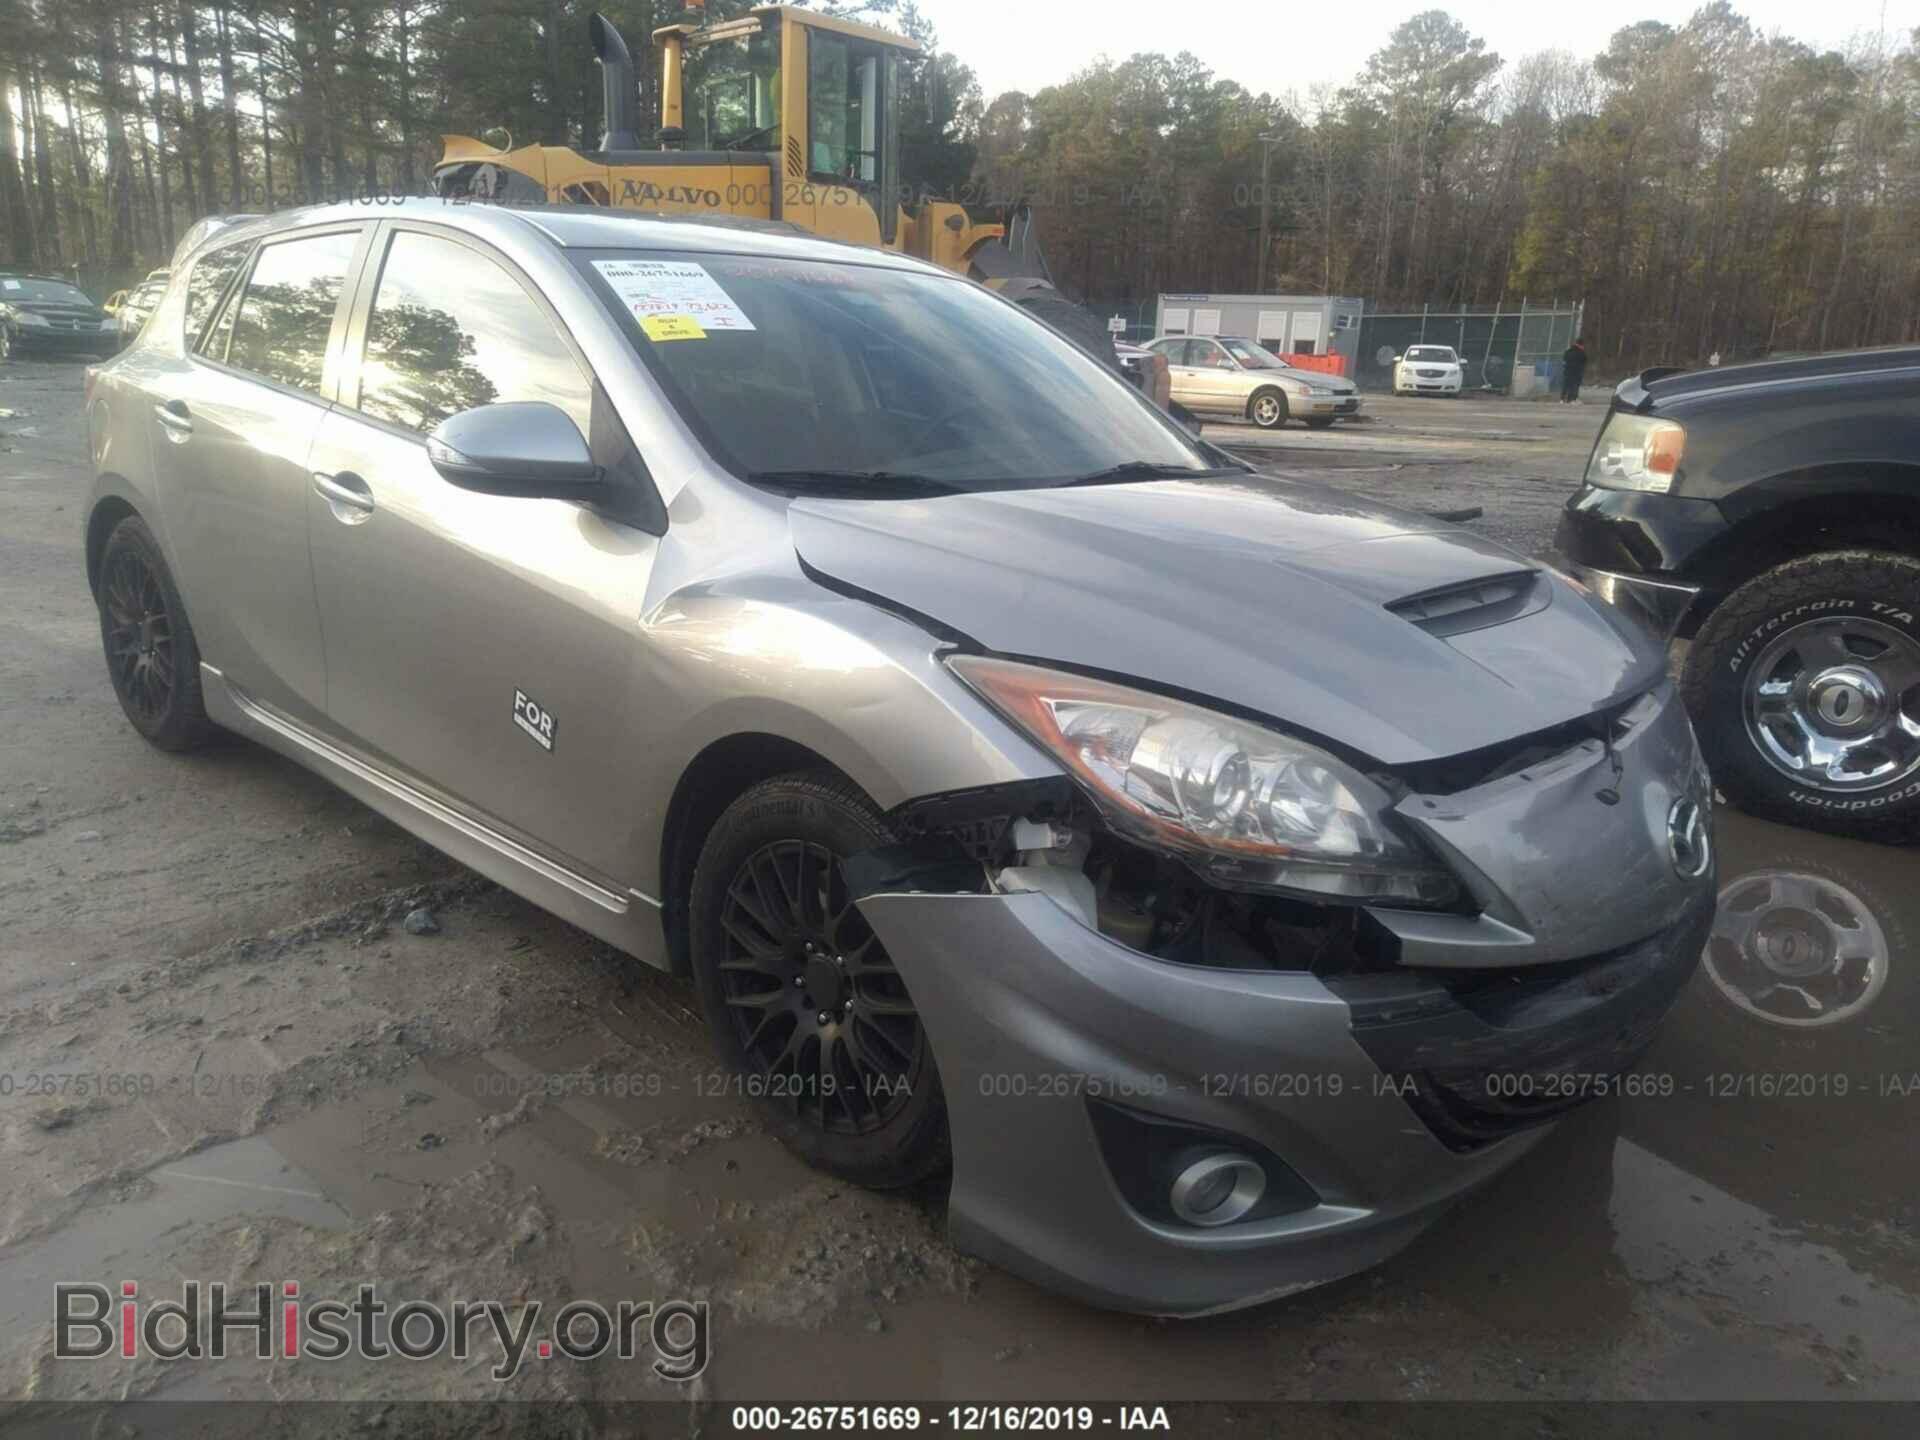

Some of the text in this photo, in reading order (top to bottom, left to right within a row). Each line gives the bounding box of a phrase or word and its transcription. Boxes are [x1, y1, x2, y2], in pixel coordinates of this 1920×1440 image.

[1729, 599, 1855, 673] All-Terrain
[1871, 600, 1913, 624] T/A
[515, 690, 551, 738] FOR
